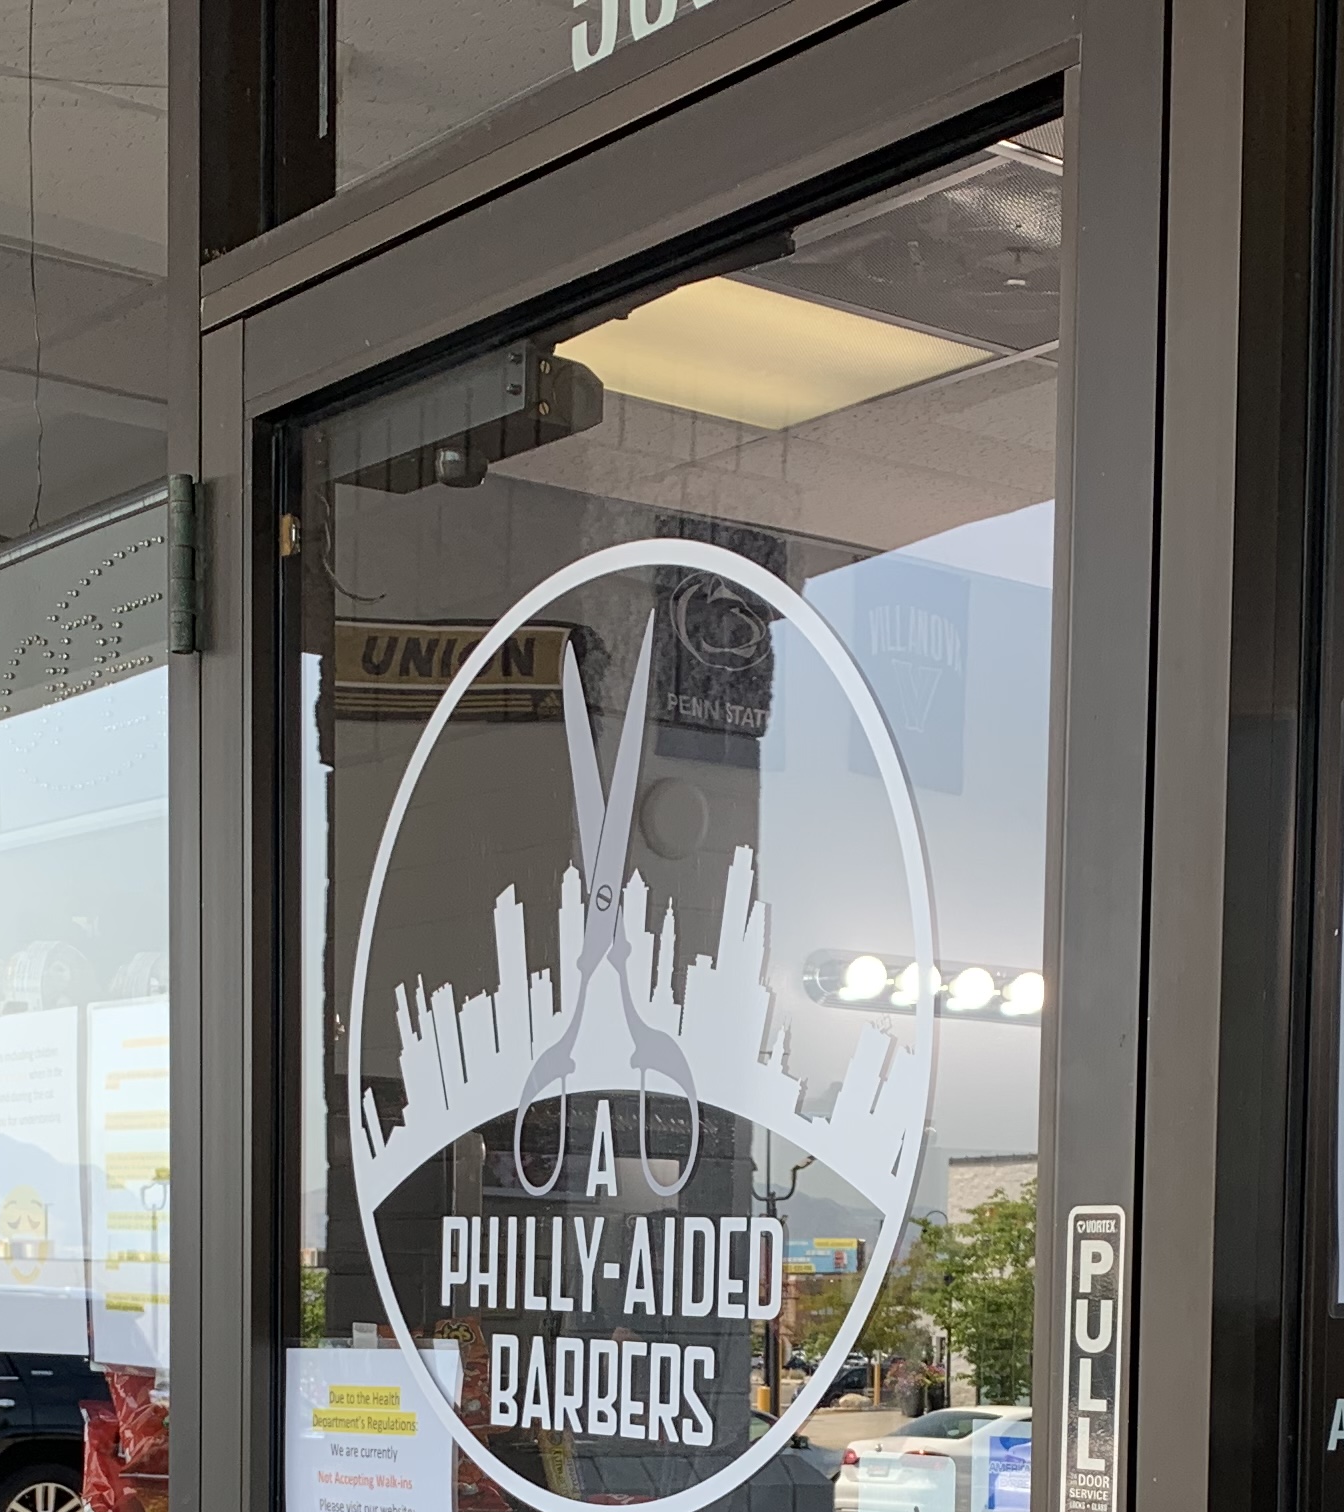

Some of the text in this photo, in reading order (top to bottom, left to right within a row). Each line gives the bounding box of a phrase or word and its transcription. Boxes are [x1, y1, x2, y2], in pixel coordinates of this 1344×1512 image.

[667, 692, 720, 721] PENN
[586, 1099, 617, 1198] A
[1085, 1218, 1117, 1234] VORTEX
[440, 1215, 783, 1322] PHILLY-AIDED
[1075, 1239, 1114, 1472] PULL
[329, 1390, 400, 1406] Due to the Health
[490, 1333, 716, 1447] BARBERS
[367, 1415, 419, 1433] Regulations:
[330, 1443, 398, 1461] We are currently
[988, 1461, 1031, 1473] AMERICA
[318, 1470, 413, 1490] Not Accepting Walk-ins
[1078, 1473, 1110, 1489] DOOR
[1069, 1487, 1109, 1501] SERVICE
[319, 1498, 344, 1512] Please
